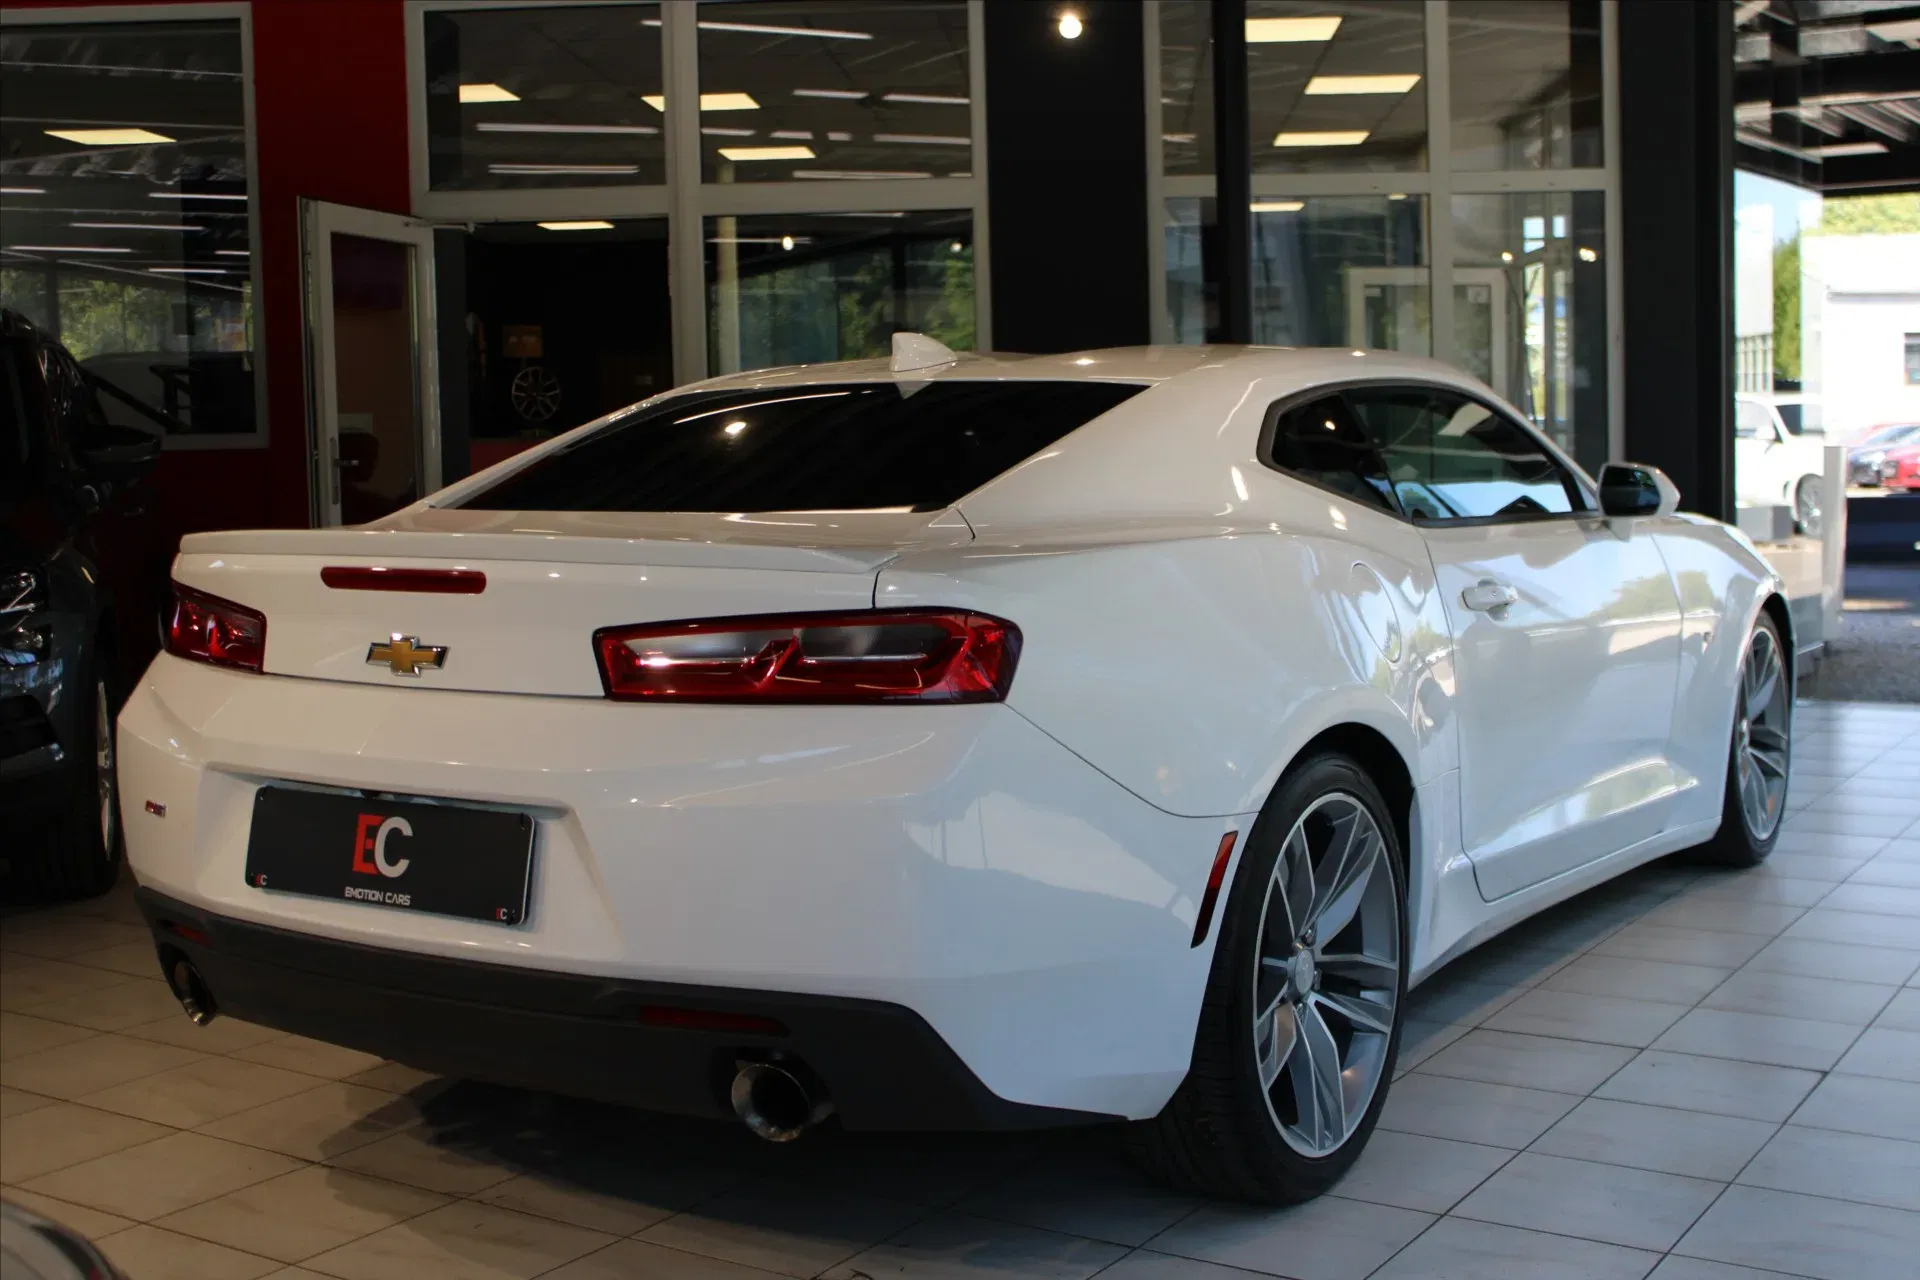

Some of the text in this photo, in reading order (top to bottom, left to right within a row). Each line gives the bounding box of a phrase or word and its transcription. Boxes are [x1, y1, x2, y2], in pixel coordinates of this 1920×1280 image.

[352, 814, 413, 878] EC
[344, 886, 411, 906] EMOTION CARS
